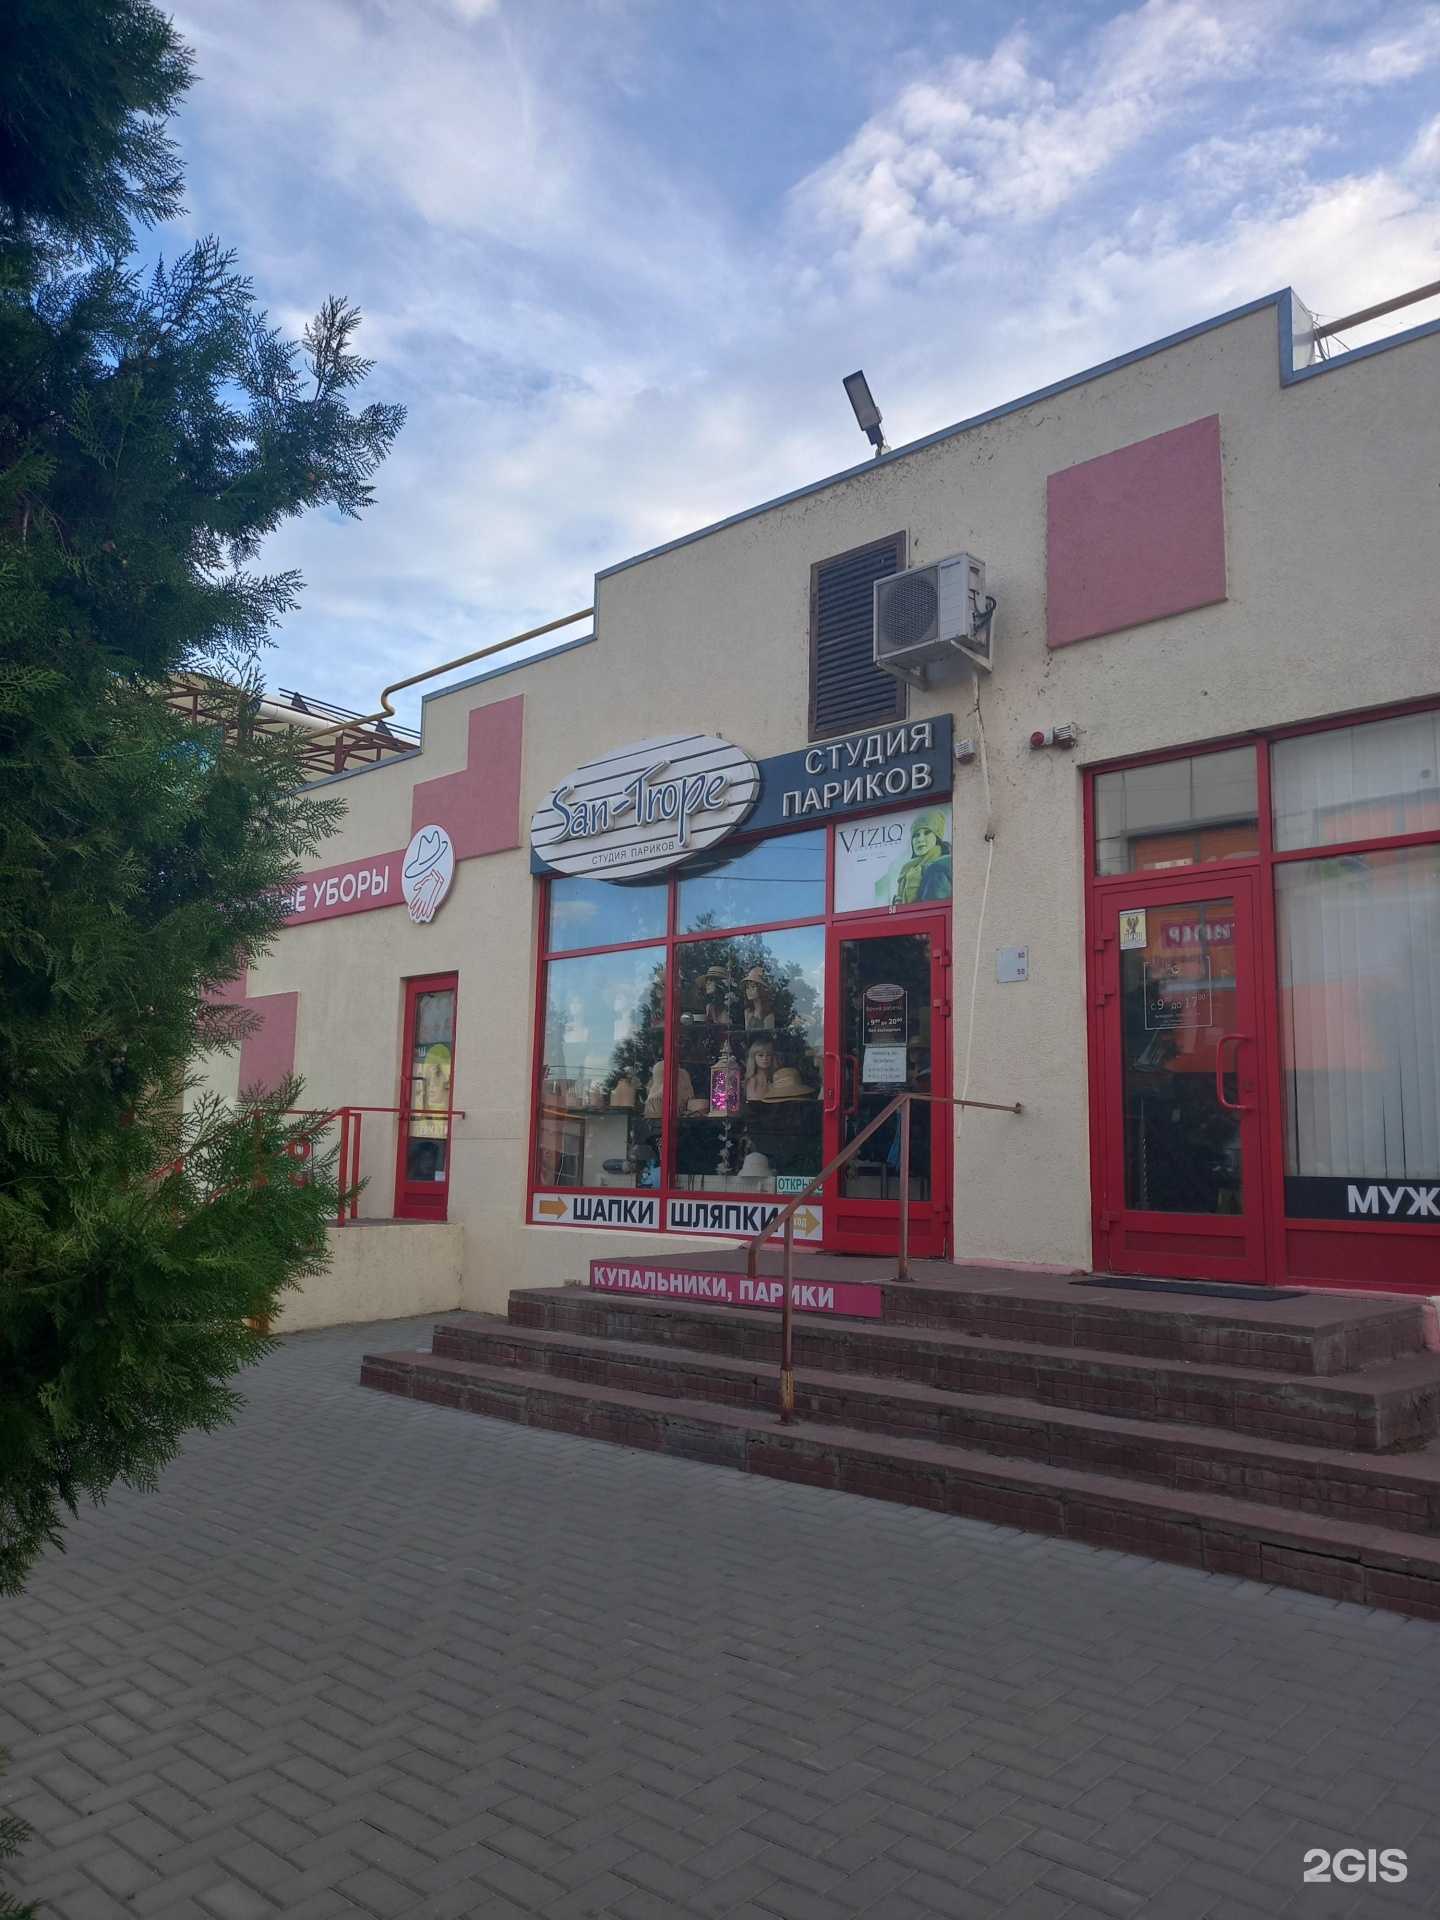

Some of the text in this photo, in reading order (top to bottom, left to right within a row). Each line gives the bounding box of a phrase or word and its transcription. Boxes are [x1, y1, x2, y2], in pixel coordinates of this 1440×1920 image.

[805, 721, 933, 774] СТУДИЯ
[549, 759, 730, 848] San-Trope
[781, 762, 933, 817] ПАРИКОВ
[591, 840, 675, 866] СТУДИЯ ПАРИКОВ
[838, 823, 903, 853] VIZIO
[313, 865, 389, 909] УБОРЫ
[573, 1197, 654, 1225] ШАПКИ
[671, 1201, 779, 1233] ШЛЯПКИ
[1347, 1184, 1440, 1217] МУЖ
[594, 1266, 733, 1302] КУПАЛЬНИКИ,
